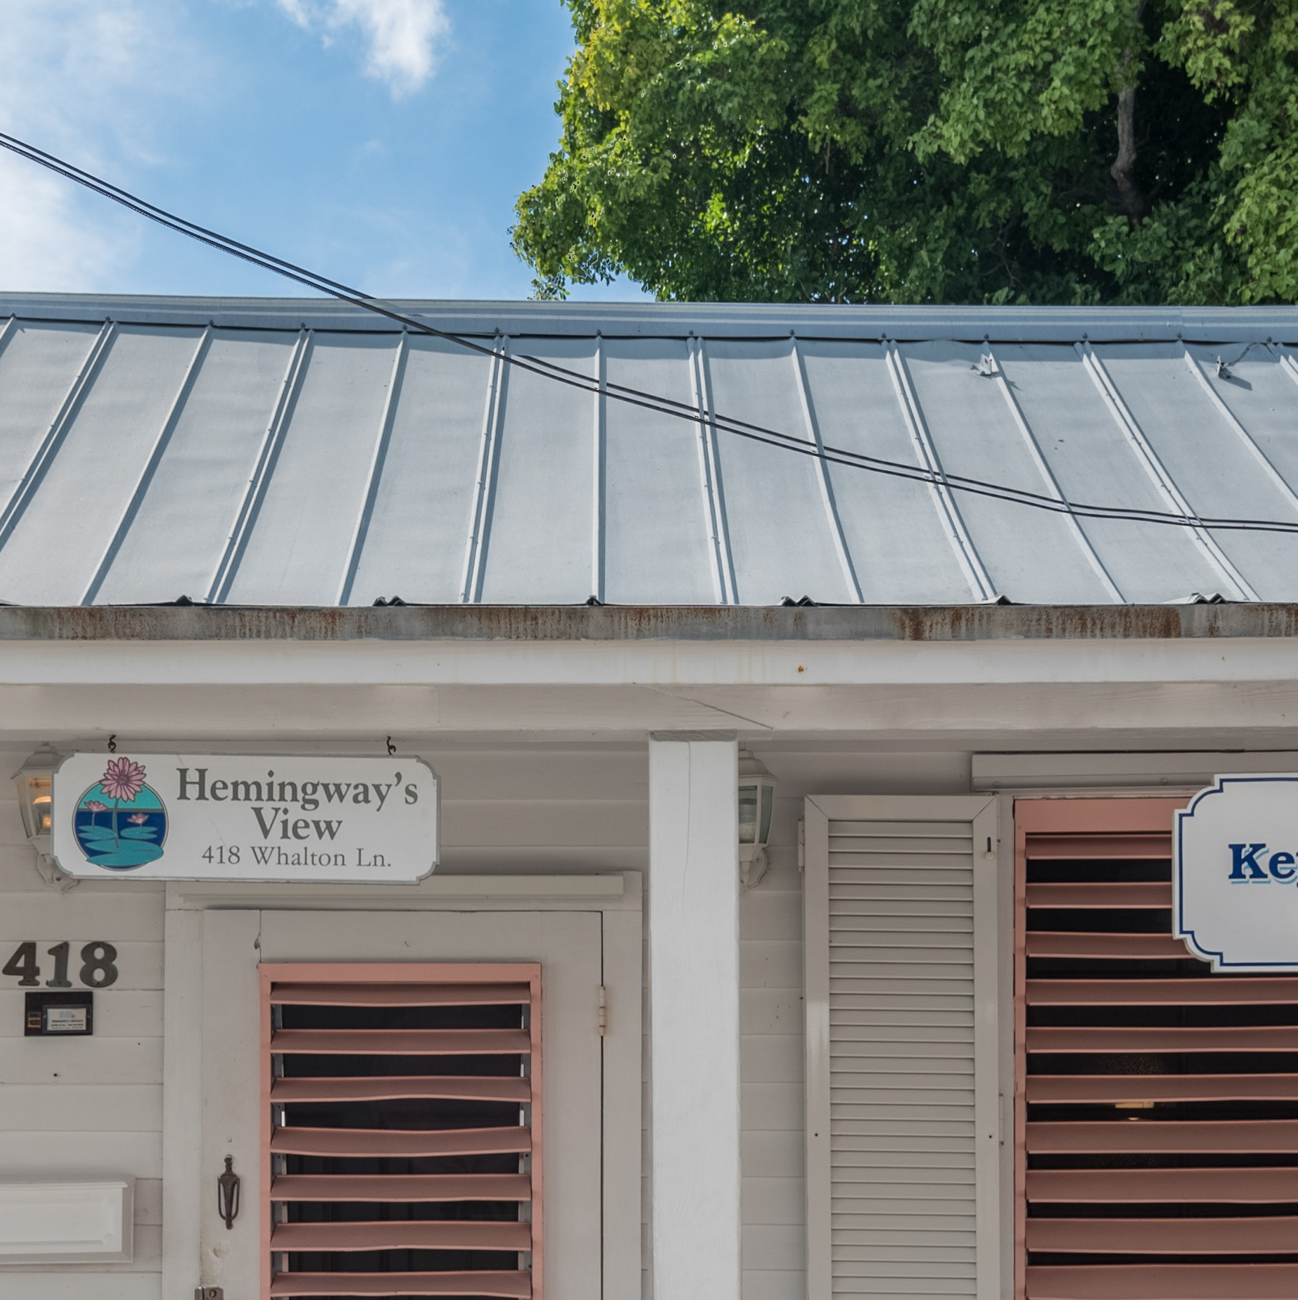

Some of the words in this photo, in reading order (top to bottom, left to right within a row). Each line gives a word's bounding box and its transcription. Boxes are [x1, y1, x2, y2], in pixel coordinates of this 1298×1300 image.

[175, 766, 420, 813] Hemingway's
[250, 805, 344, 841] View
[201, 844, 241, 865] 418
[250, 845, 347, 867] Whalton
[356, 847, 393, 868] Ln.
[1, 940, 119, 989] 418
